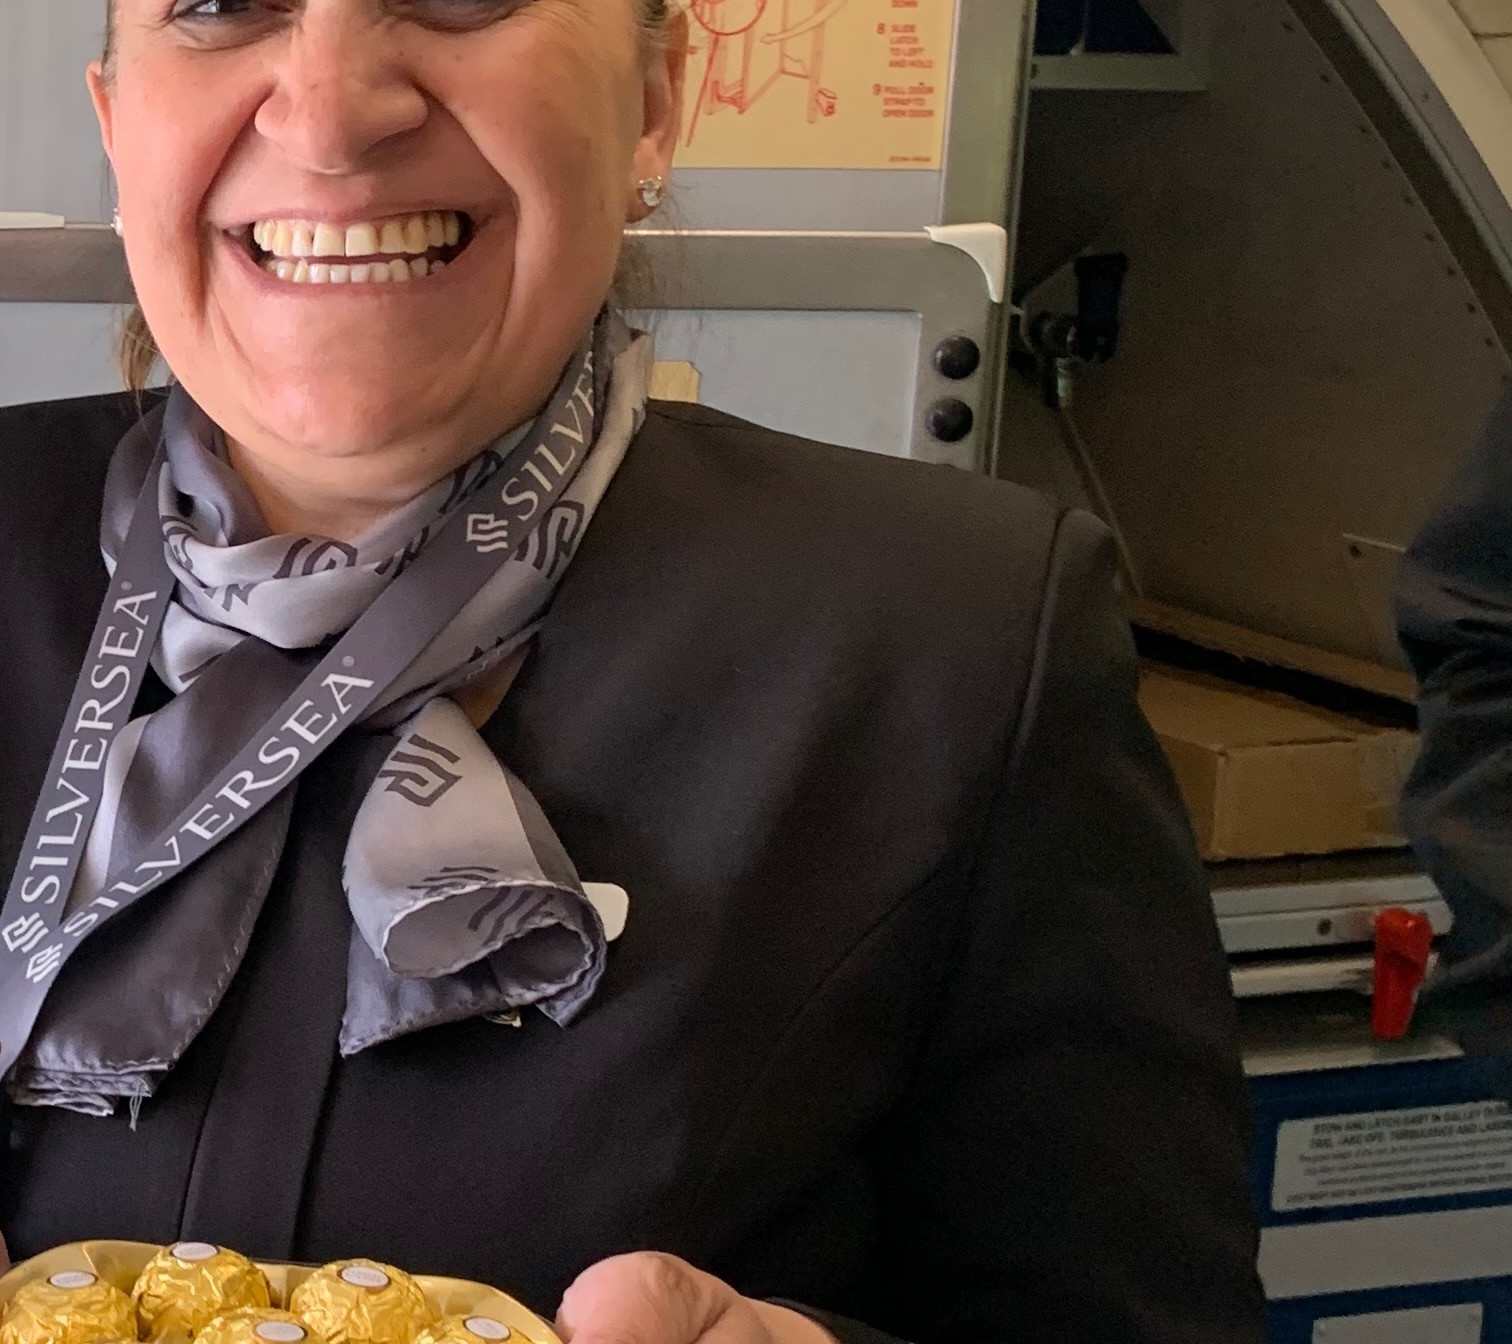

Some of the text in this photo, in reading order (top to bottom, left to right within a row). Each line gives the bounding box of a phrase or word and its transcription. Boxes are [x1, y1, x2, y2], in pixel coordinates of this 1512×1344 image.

[873, 83, 881, 95] 9
[876, 22, 885, 35] 8
[21, 590, 157, 904] SILVERSEA
[63, 672, 374, 937] SILVERSEA
